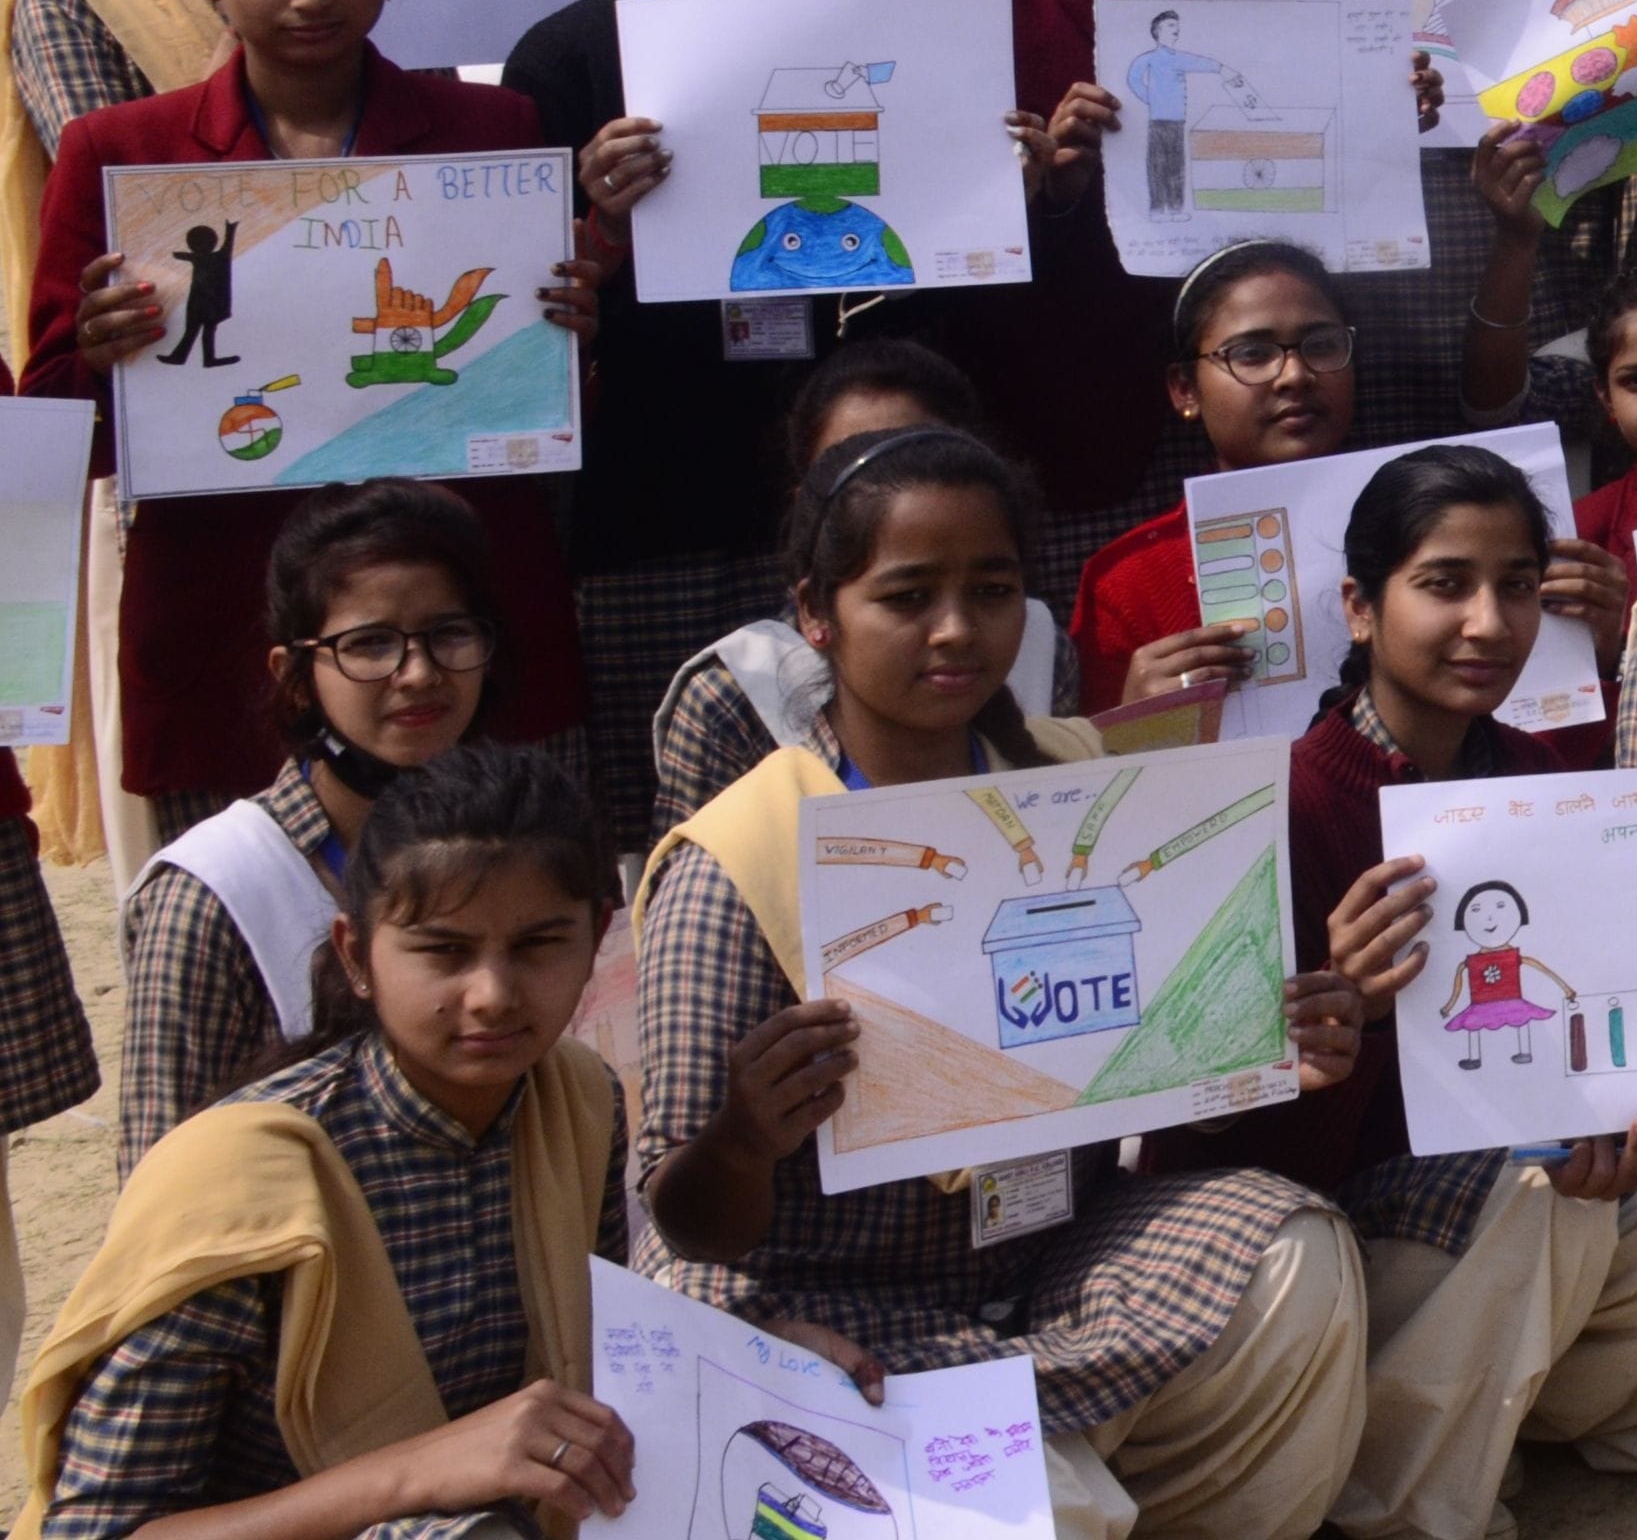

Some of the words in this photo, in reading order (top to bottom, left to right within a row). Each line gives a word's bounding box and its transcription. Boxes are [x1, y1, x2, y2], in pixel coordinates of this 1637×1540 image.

[758, 130, 878, 166] VOTE
[139, 172, 257, 216] VOTE
[292, 168, 370, 208] FOR
[393, 171, 412, 202] A
[437, 163, 557, 200] BETTER
[293, 215, 403, 251] INDIA
